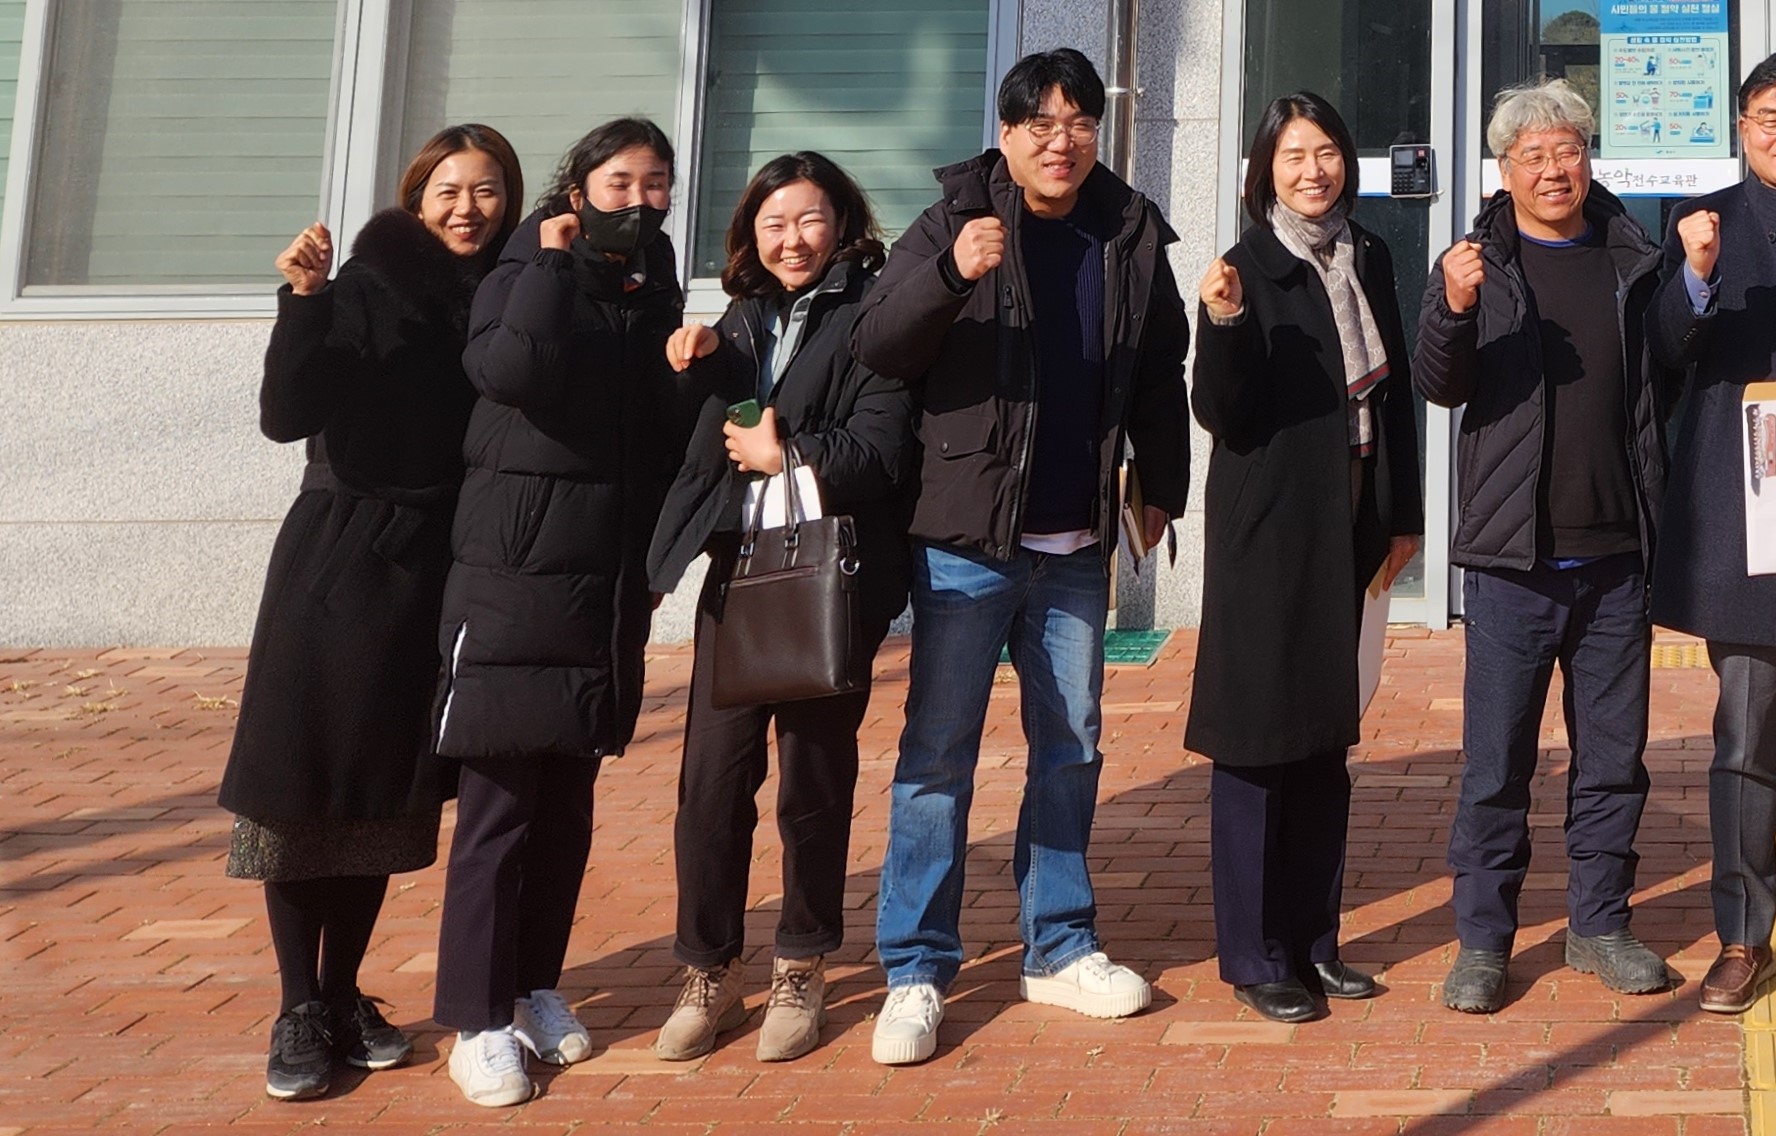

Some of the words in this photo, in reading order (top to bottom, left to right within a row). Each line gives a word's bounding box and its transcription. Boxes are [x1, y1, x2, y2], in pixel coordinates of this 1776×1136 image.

[1611, 4, 1648, 15] 시민들의
[1649, 4, 1659, 14] 물
[1661, 4, 1679, 14] 절약
[1681, 4, 1700, 14] 실천
[1702, 4, 1720, 14] 절실
